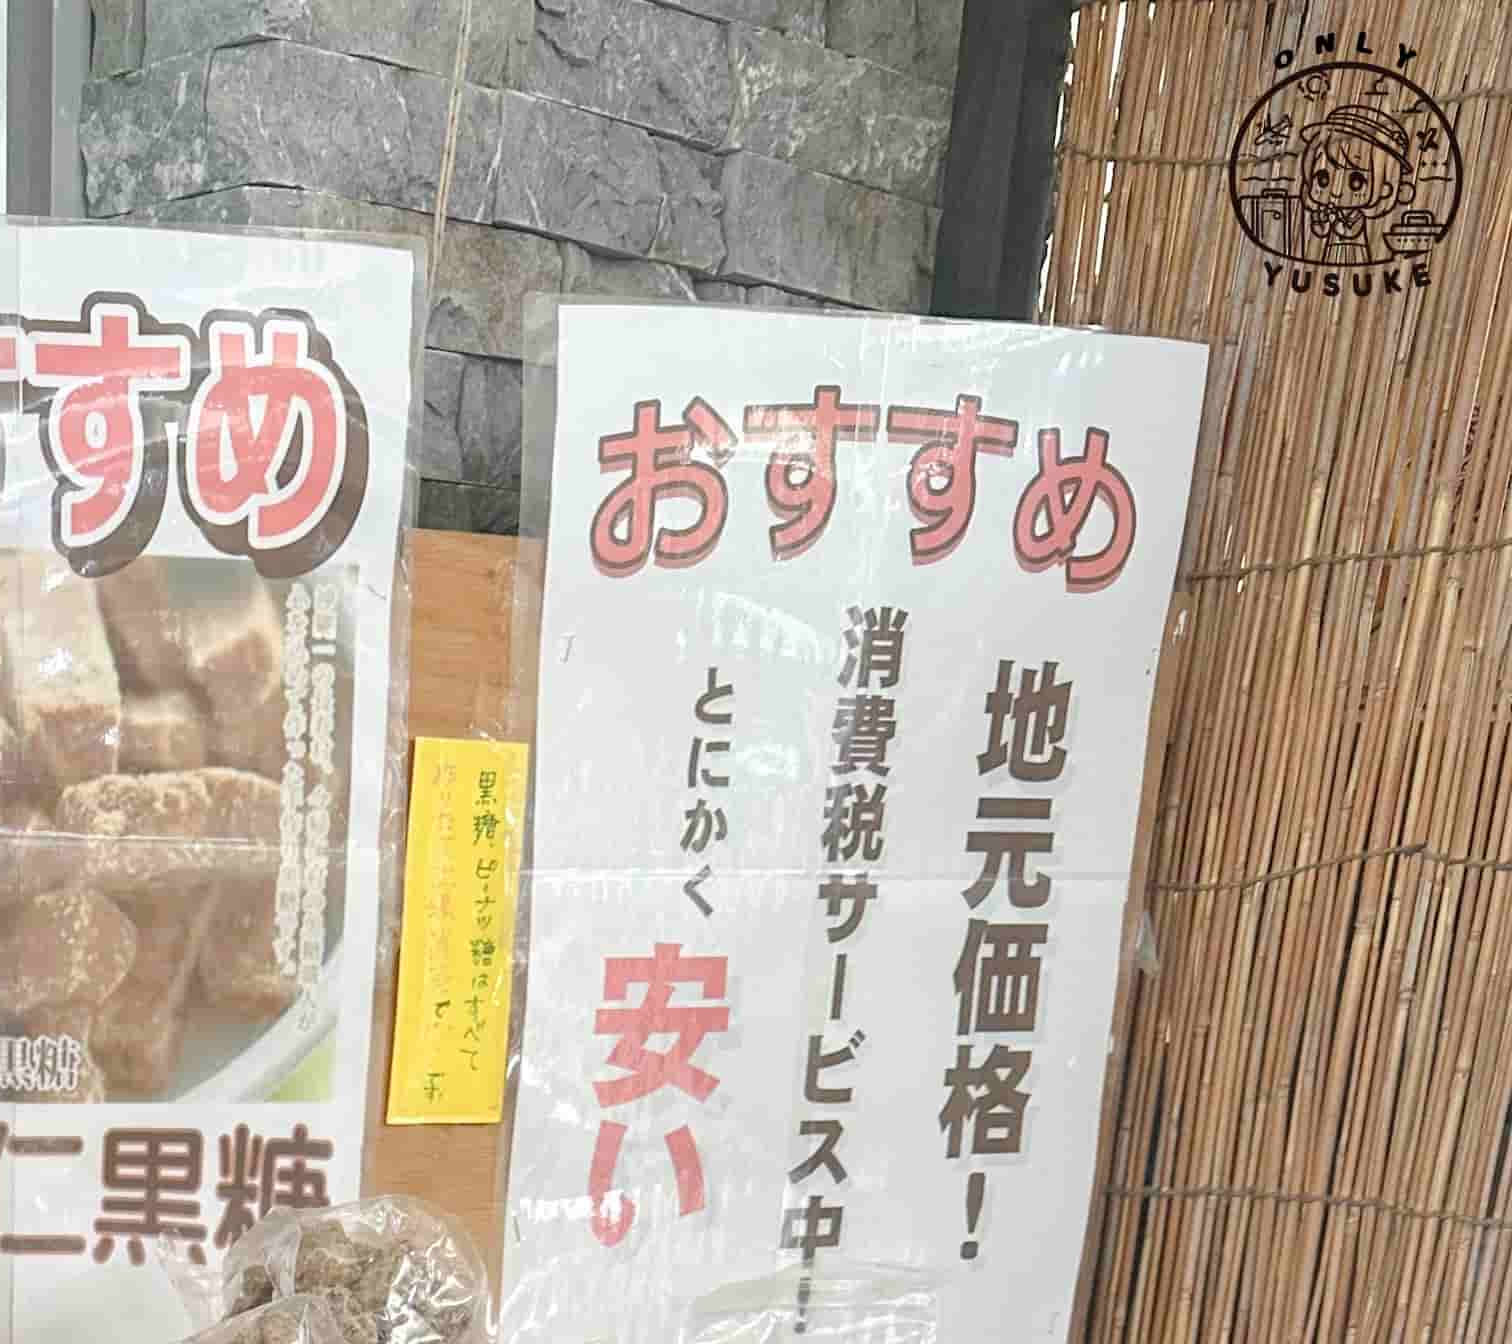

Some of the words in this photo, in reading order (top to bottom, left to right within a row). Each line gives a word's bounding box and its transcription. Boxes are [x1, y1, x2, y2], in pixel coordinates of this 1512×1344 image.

[589, 384, 1138, 594] おすすめ
[938, 659, 1076, 1262] 地元価格!
